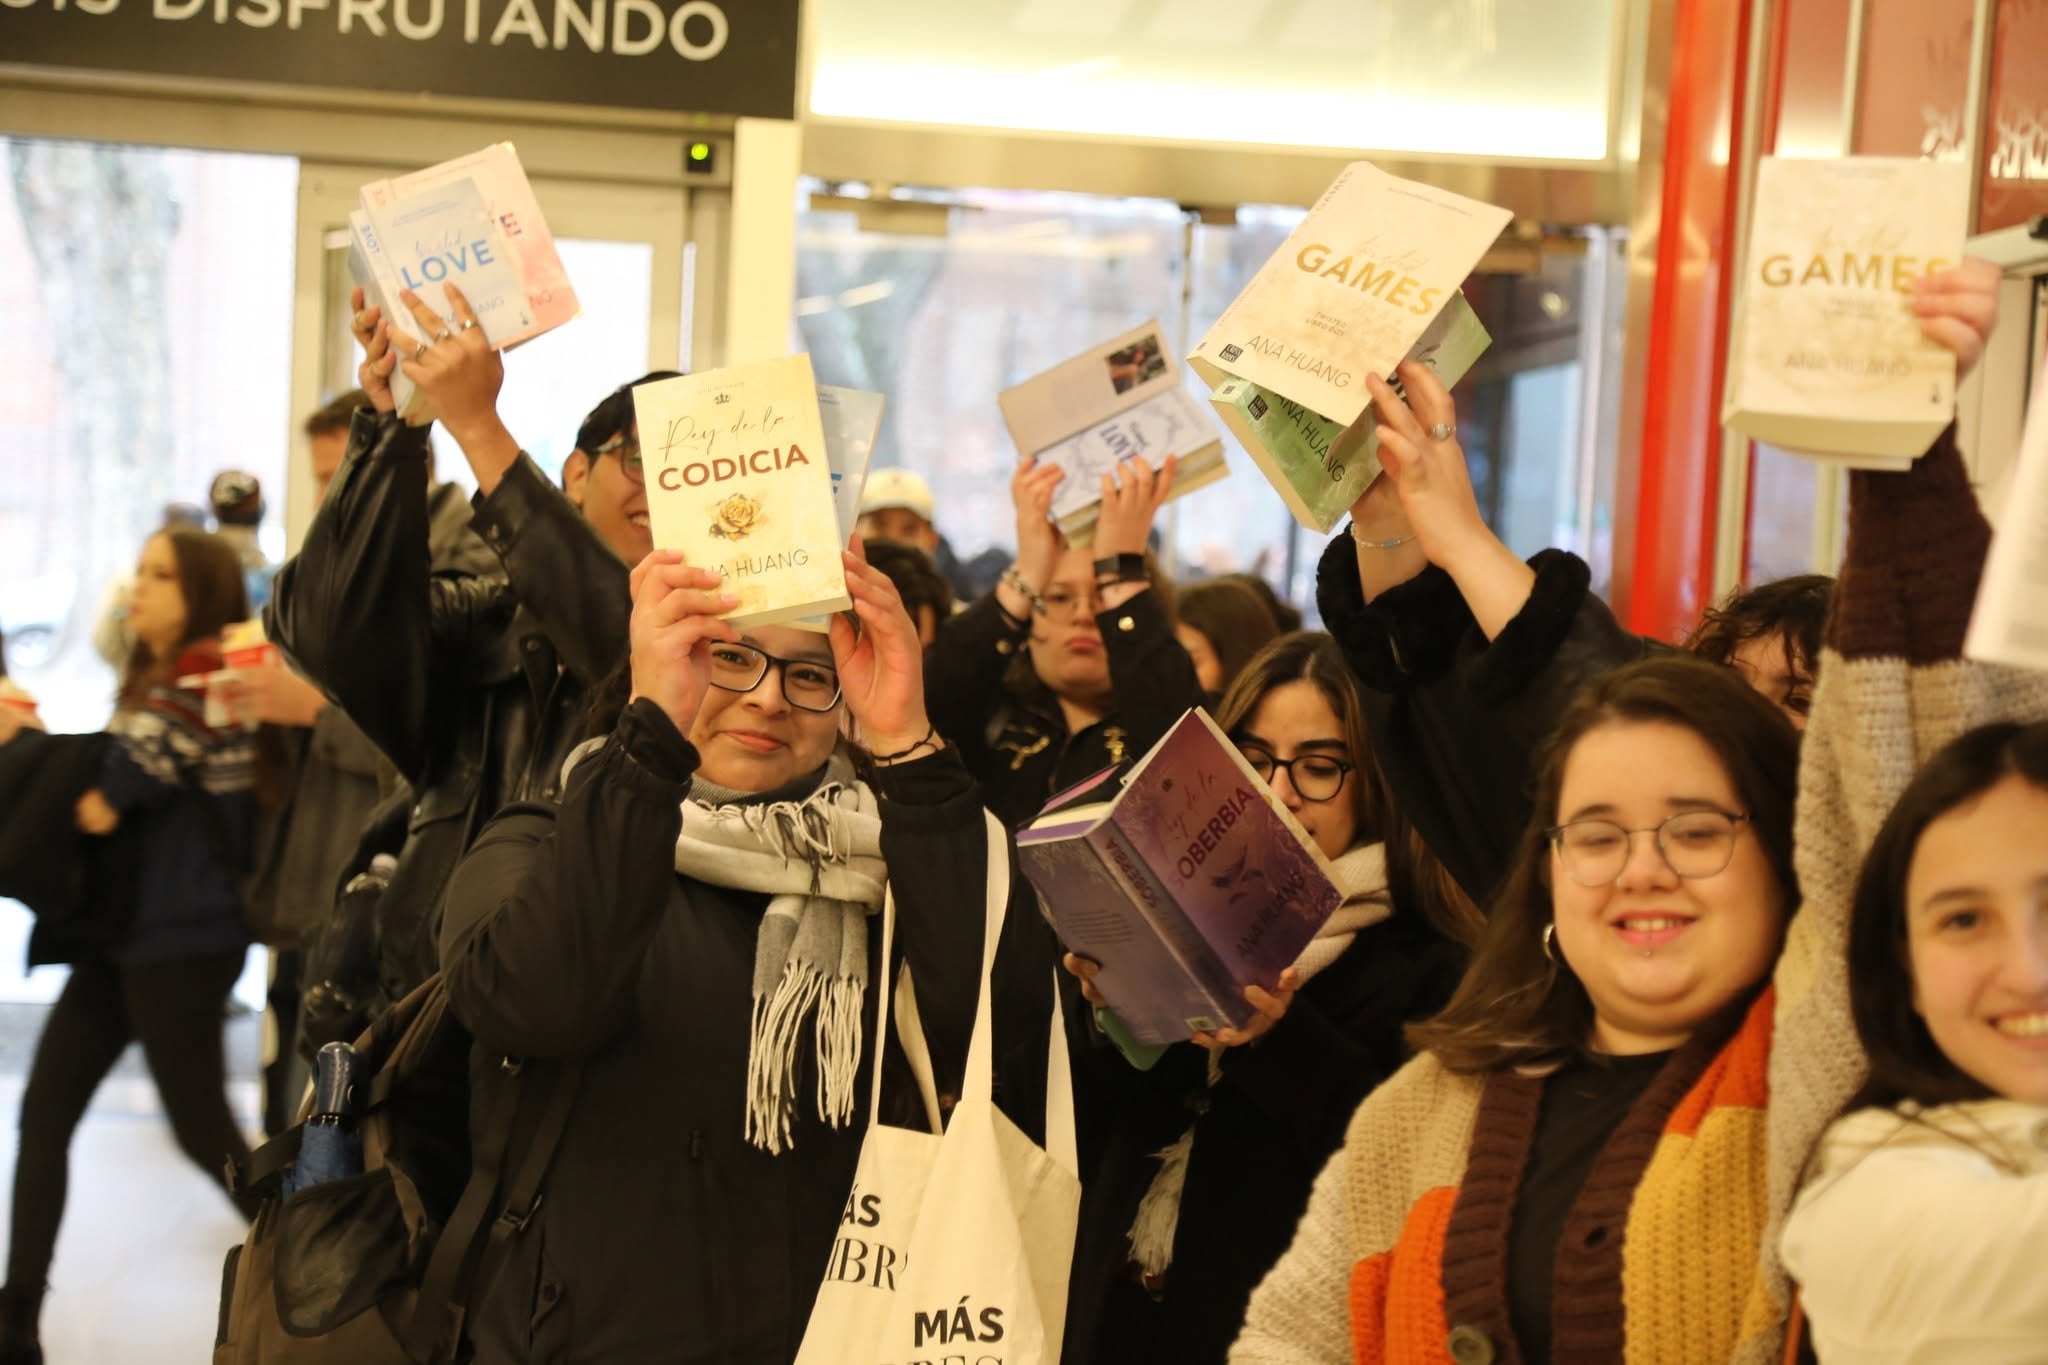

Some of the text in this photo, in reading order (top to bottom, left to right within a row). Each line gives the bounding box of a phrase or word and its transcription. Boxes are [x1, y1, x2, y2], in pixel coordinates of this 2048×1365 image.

[401, 239, 495, 290] LOVE
[1296, 243, 1442, 316] GAMES
[1245, 334, 1352, 388] ANA HUANG
[658, 415, 717, 463] Rey
[1274, 392, 1347, 483] ANA HUANG
[658, 443, 810, 491] CODICIA
[736, 549, 809, 578] HUANG
[841, 1184, 882, 1228] ÁS
[914, 1295, 1005, 1348] MÁS
